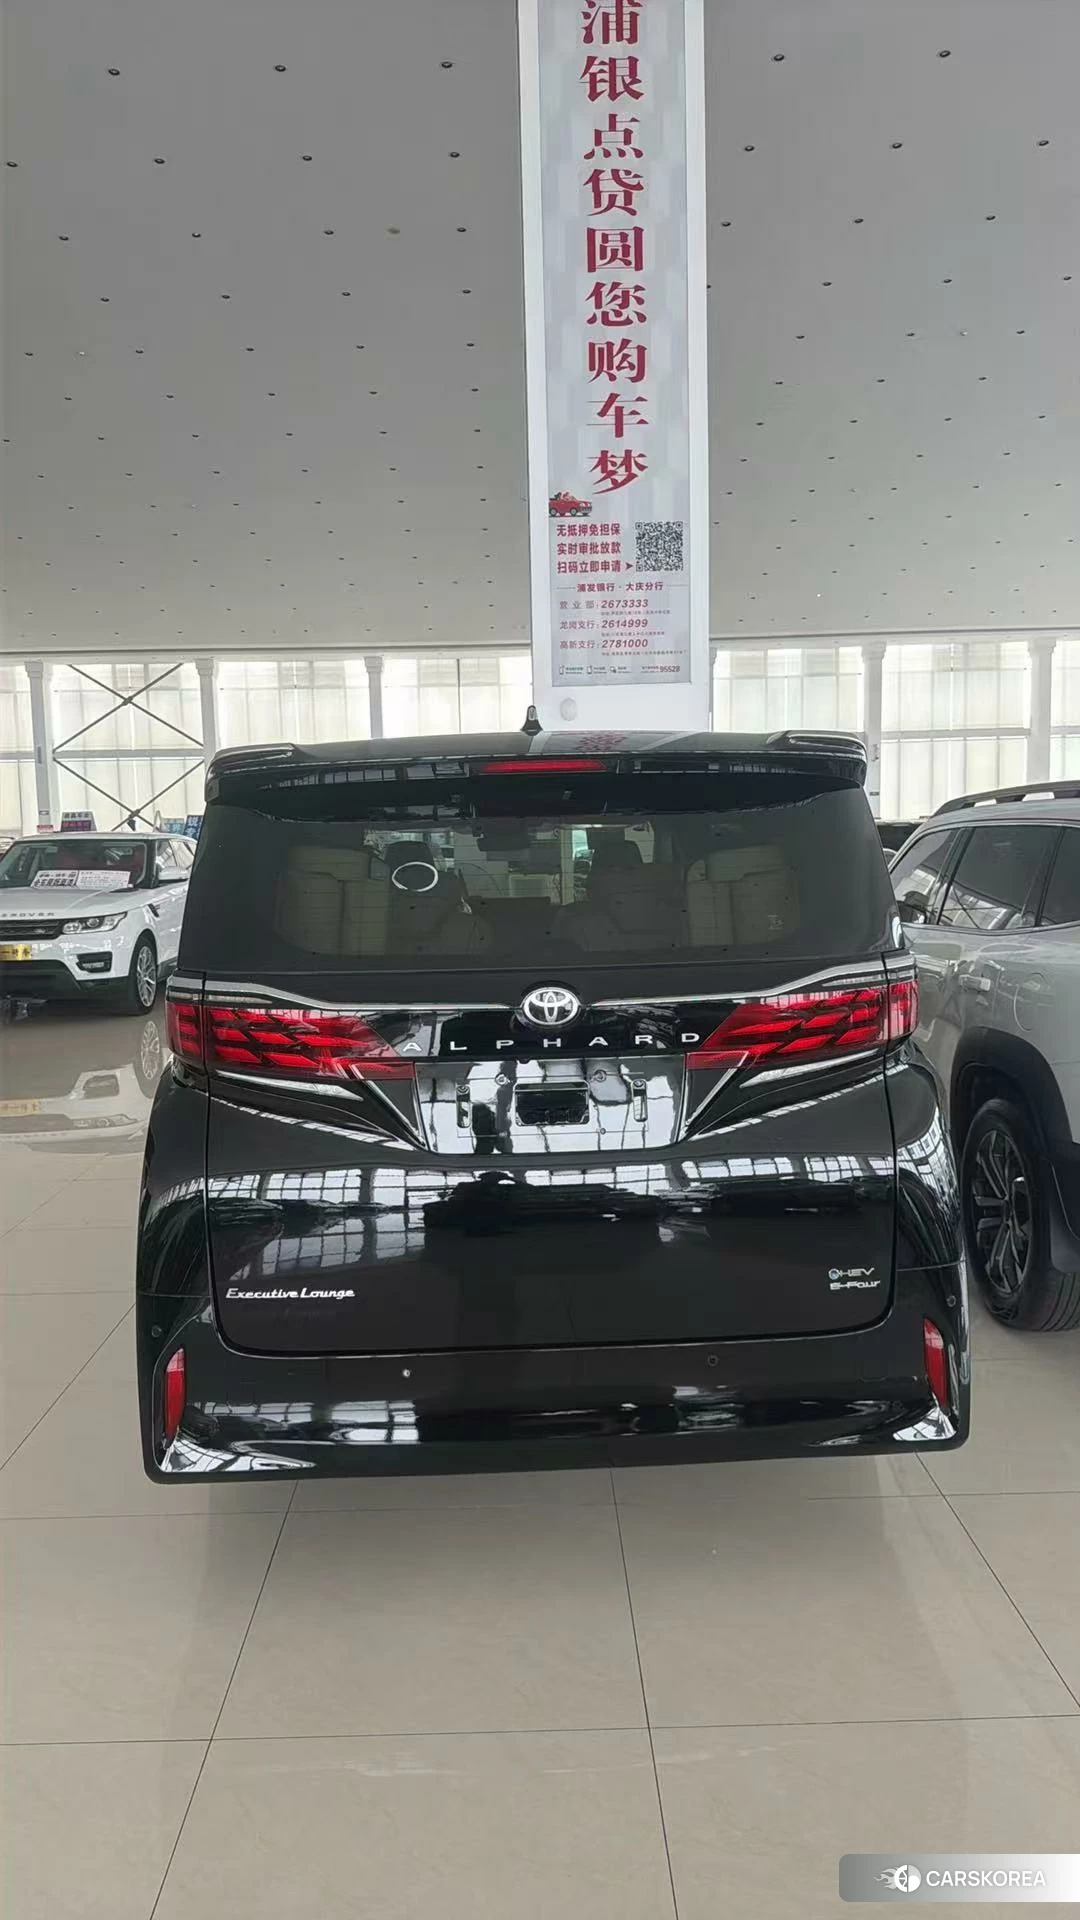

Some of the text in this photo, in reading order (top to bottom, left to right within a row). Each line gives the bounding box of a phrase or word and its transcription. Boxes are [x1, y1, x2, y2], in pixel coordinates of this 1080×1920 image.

[579, 0, 649, 495] 浦银点贷圆您购车梦
[556, 523, 621, 537] 无抵押免担保
[556, 541, 621, 556] 实时审批放款
[557, 560, 621, 574] 扫码立即申请
[601, 599, 649, 608] 2673333
[602, 619, 648, 628] 2614999
[602, 639, 648, 648] 2781000
[403, 1033, 700, 1052] ALPHARD
[226, 1287, 355, 1300] Executive Lounge
